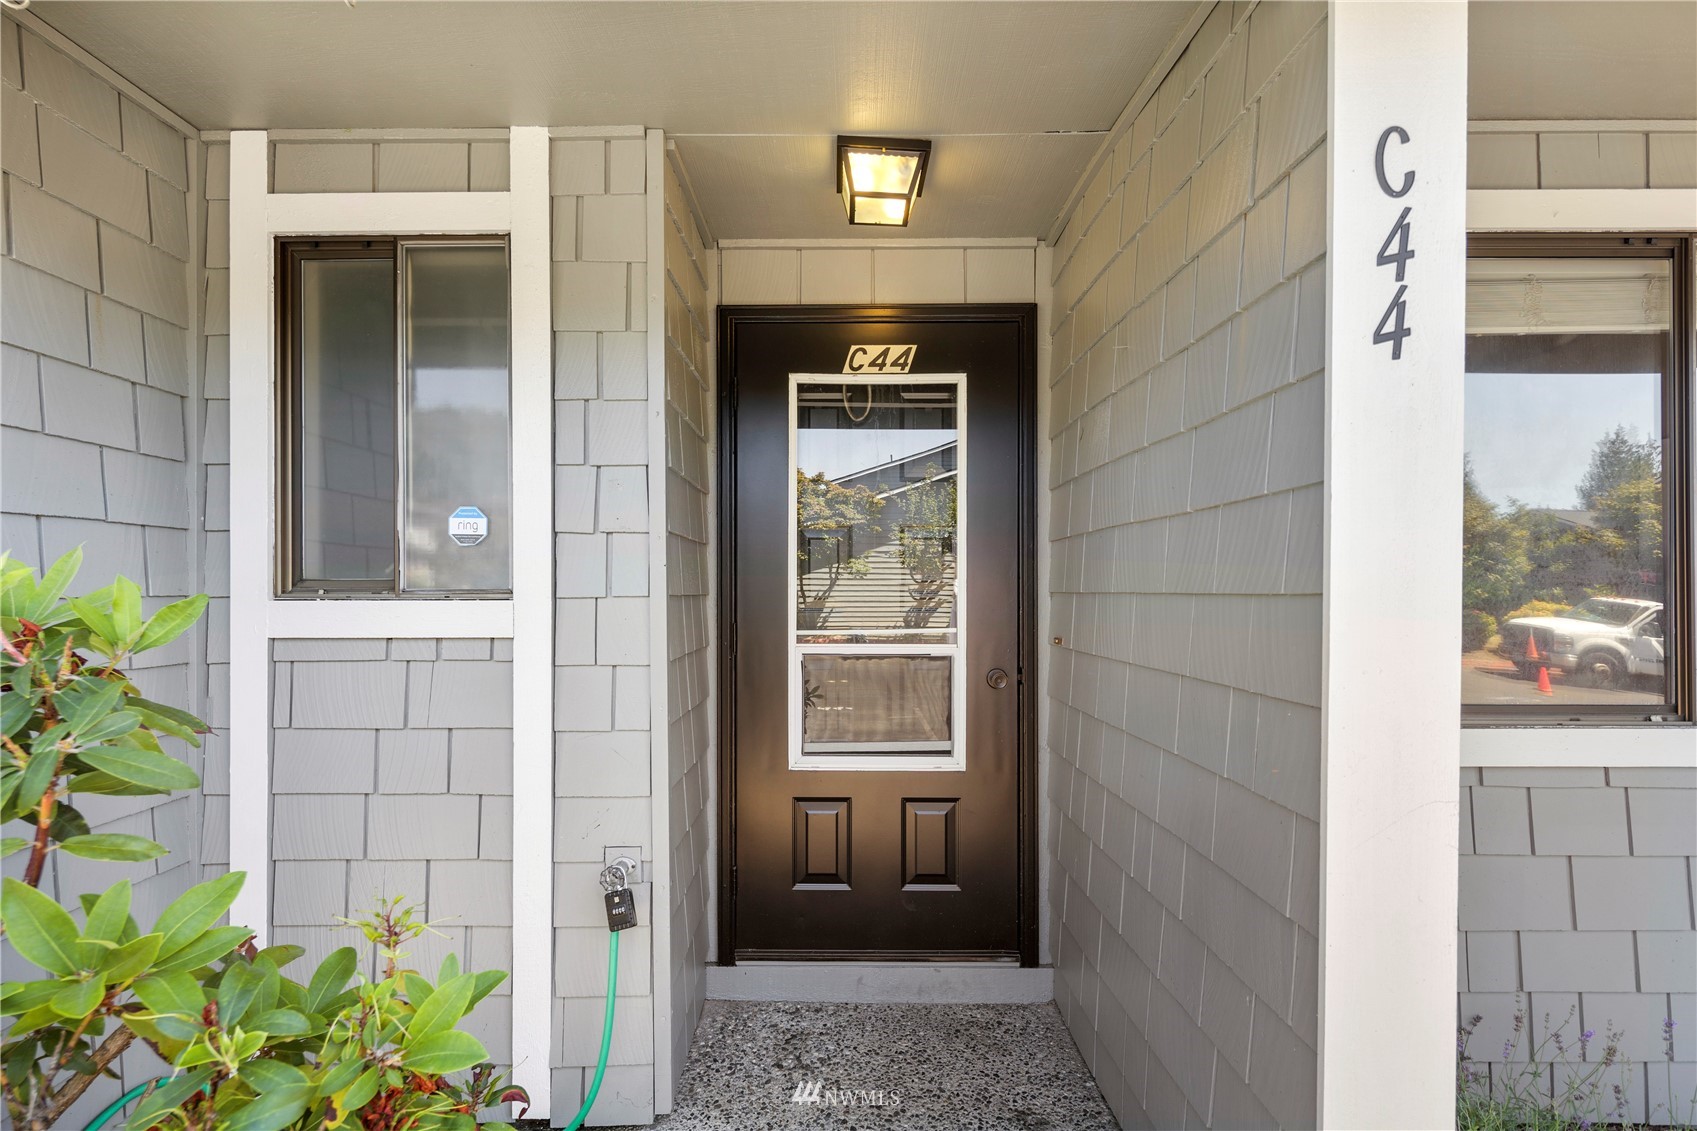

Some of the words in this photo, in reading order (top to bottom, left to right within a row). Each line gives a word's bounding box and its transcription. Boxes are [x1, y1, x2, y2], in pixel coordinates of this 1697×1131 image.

[1373, 125, 1416, 360] C44
[848, 346, 913, 372] C44
[457, 520, 479, 533] ring
